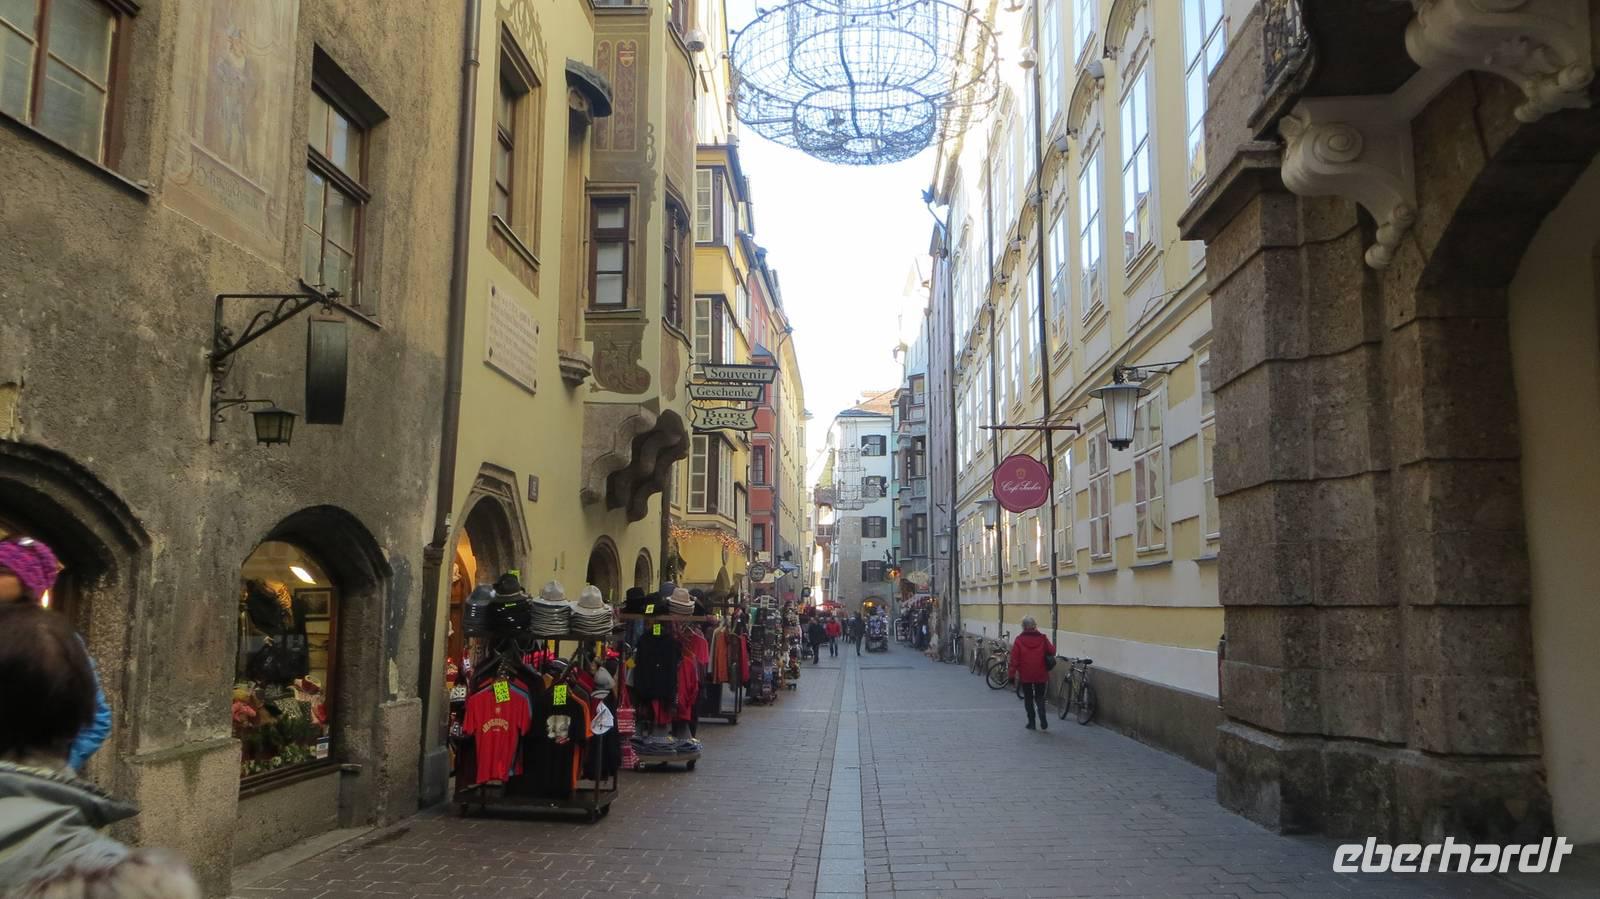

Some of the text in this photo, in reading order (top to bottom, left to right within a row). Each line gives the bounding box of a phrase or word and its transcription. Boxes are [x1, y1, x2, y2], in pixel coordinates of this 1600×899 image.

[711, 368, 768, 380] Souvenir
[697, 387, 753, 397] Geschenke
[703, 417, 748, 425] Riese
[706, 411, 745, 421] Burg
